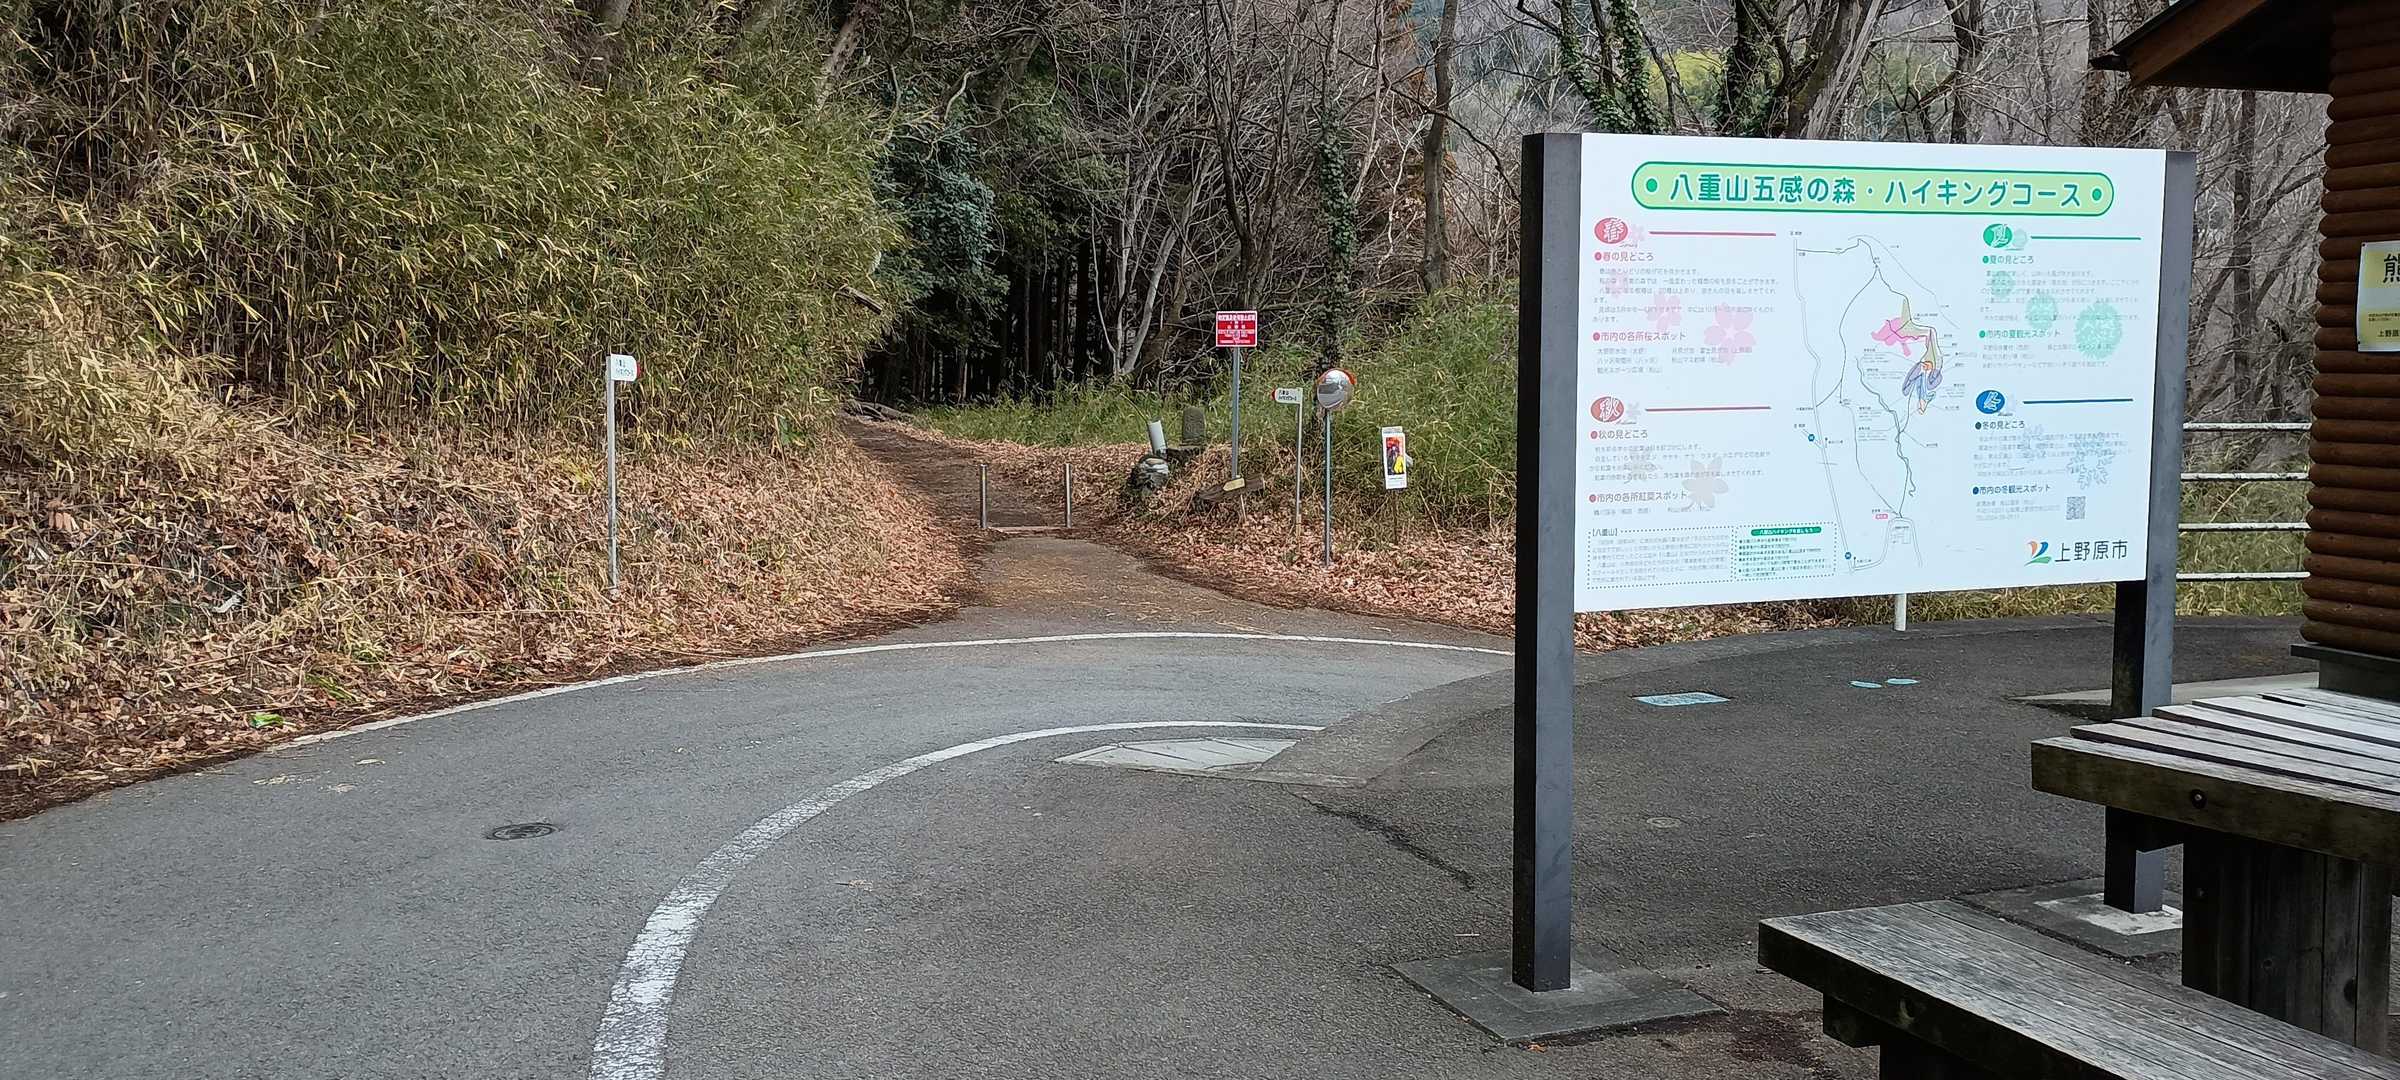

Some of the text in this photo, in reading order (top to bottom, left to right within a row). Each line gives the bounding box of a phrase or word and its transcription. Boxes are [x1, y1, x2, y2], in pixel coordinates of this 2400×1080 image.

[1670, 174, 2081, 207] 八重山五感の森・ハイキングコース
[1604, 220, 1623, 242] 春
[1603, 251, 1654, 262] 春の見どころ
[1990, 255, 2034, 265] 夏の見どころ
[1600, 396, 1620, 422] 秋
[1982, 420, 2025, 430] 冬の見どころ
[1599, 429, 1648, 440] 秋の見どころ
[1979, 484, 2051, 496] 市内の冬観光スポット
[2054, 539, 2129, 562] 上野原市
